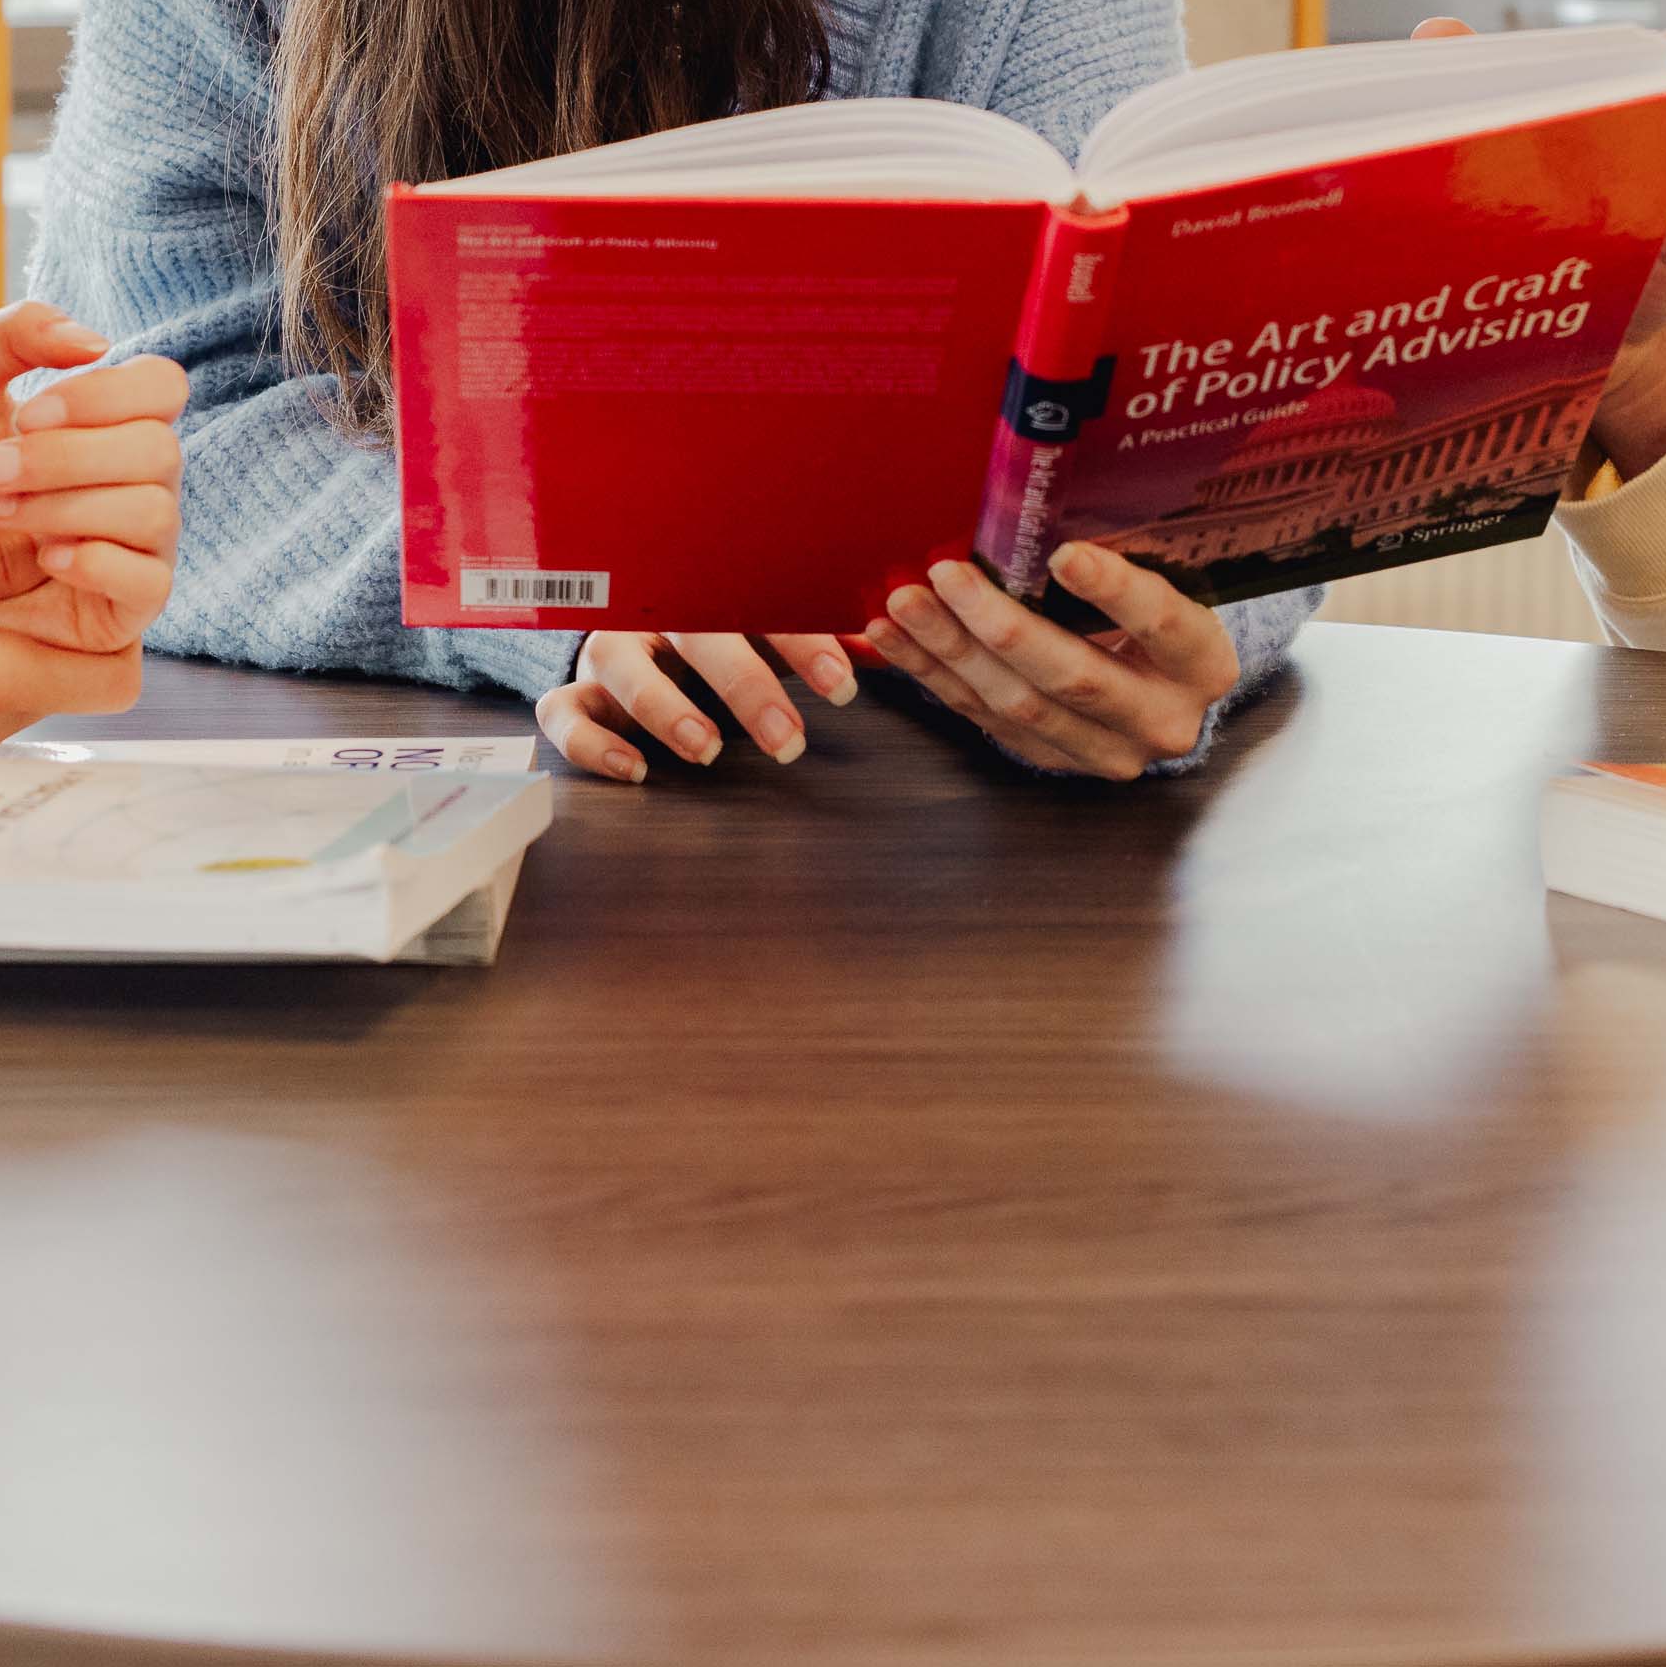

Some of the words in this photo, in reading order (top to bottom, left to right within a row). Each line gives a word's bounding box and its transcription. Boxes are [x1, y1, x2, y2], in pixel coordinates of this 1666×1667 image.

[1171, 209, 1242, 238] David
[1139, 339, 1234, 380] The
[1247, 314, 1334, 358] Art
[1345, 285, 1452, 337] and
[1463, 257, 1593, 311] Craft
[1125, 377, 1189, 420] of
[1193, 349, 1353, 408] Policy
[1362, 301, 1592, 372] Advising
[1117, 433, 1134, 451] A
[1140, 412, 1235, 445] Practical
[1242, 399, 1310, 426] Guide
[1409, 513, 1506, 542] Springer
